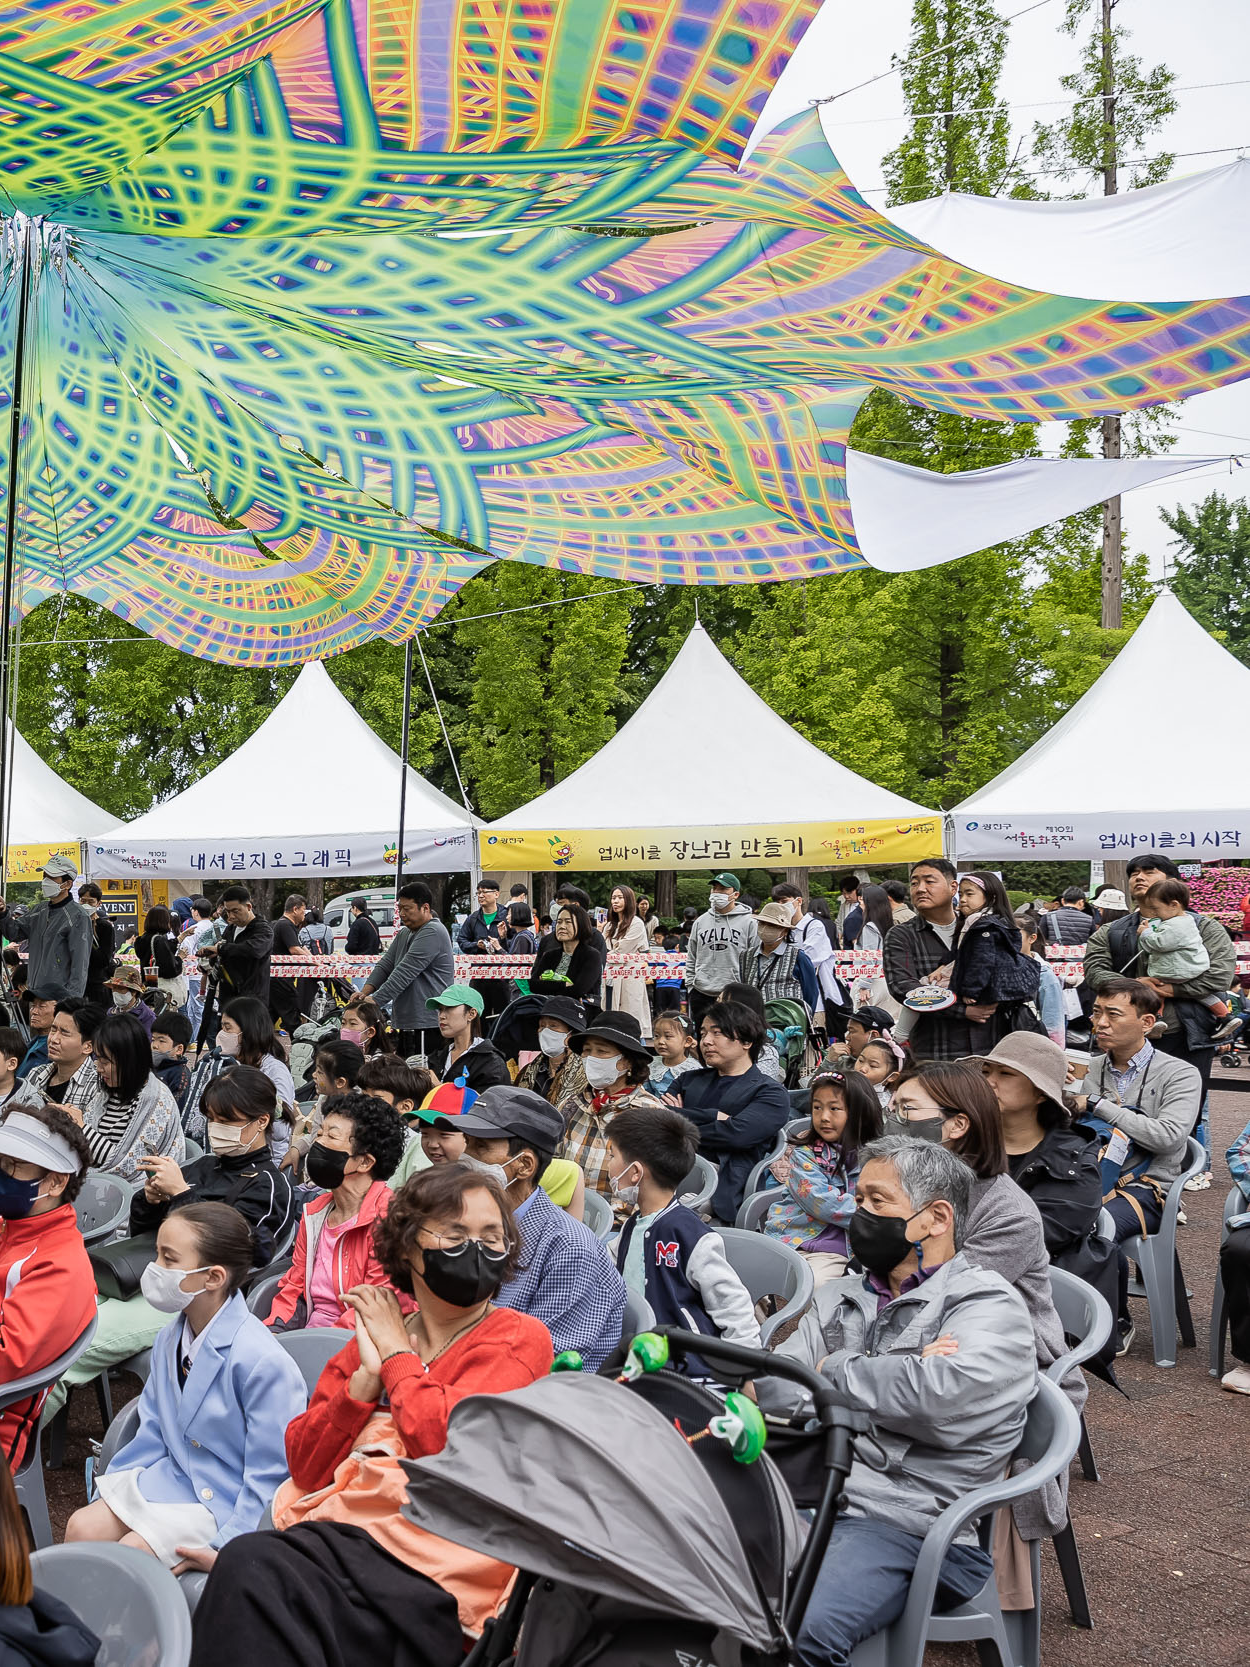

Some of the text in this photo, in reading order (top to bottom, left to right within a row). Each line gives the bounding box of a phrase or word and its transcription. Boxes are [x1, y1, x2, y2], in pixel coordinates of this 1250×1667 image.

[981, 823, 1012, 831] 광진구
[1046, 825, 1074, 833] 제10회
[500, 837, 525, 845] 광진구
[1004, 831, 1074, 848] 서울동화축제
[1099, 830, 1242, 849] 업싸이클의 시작
[598, 836, 804, 862] 업싸이클 장난감 만들기
[121, 855, 167, 870] 서울동화축제
[190, 848, 351, 871] 내셔널지오그래픽
[700, 927, 741, 947] YALE
